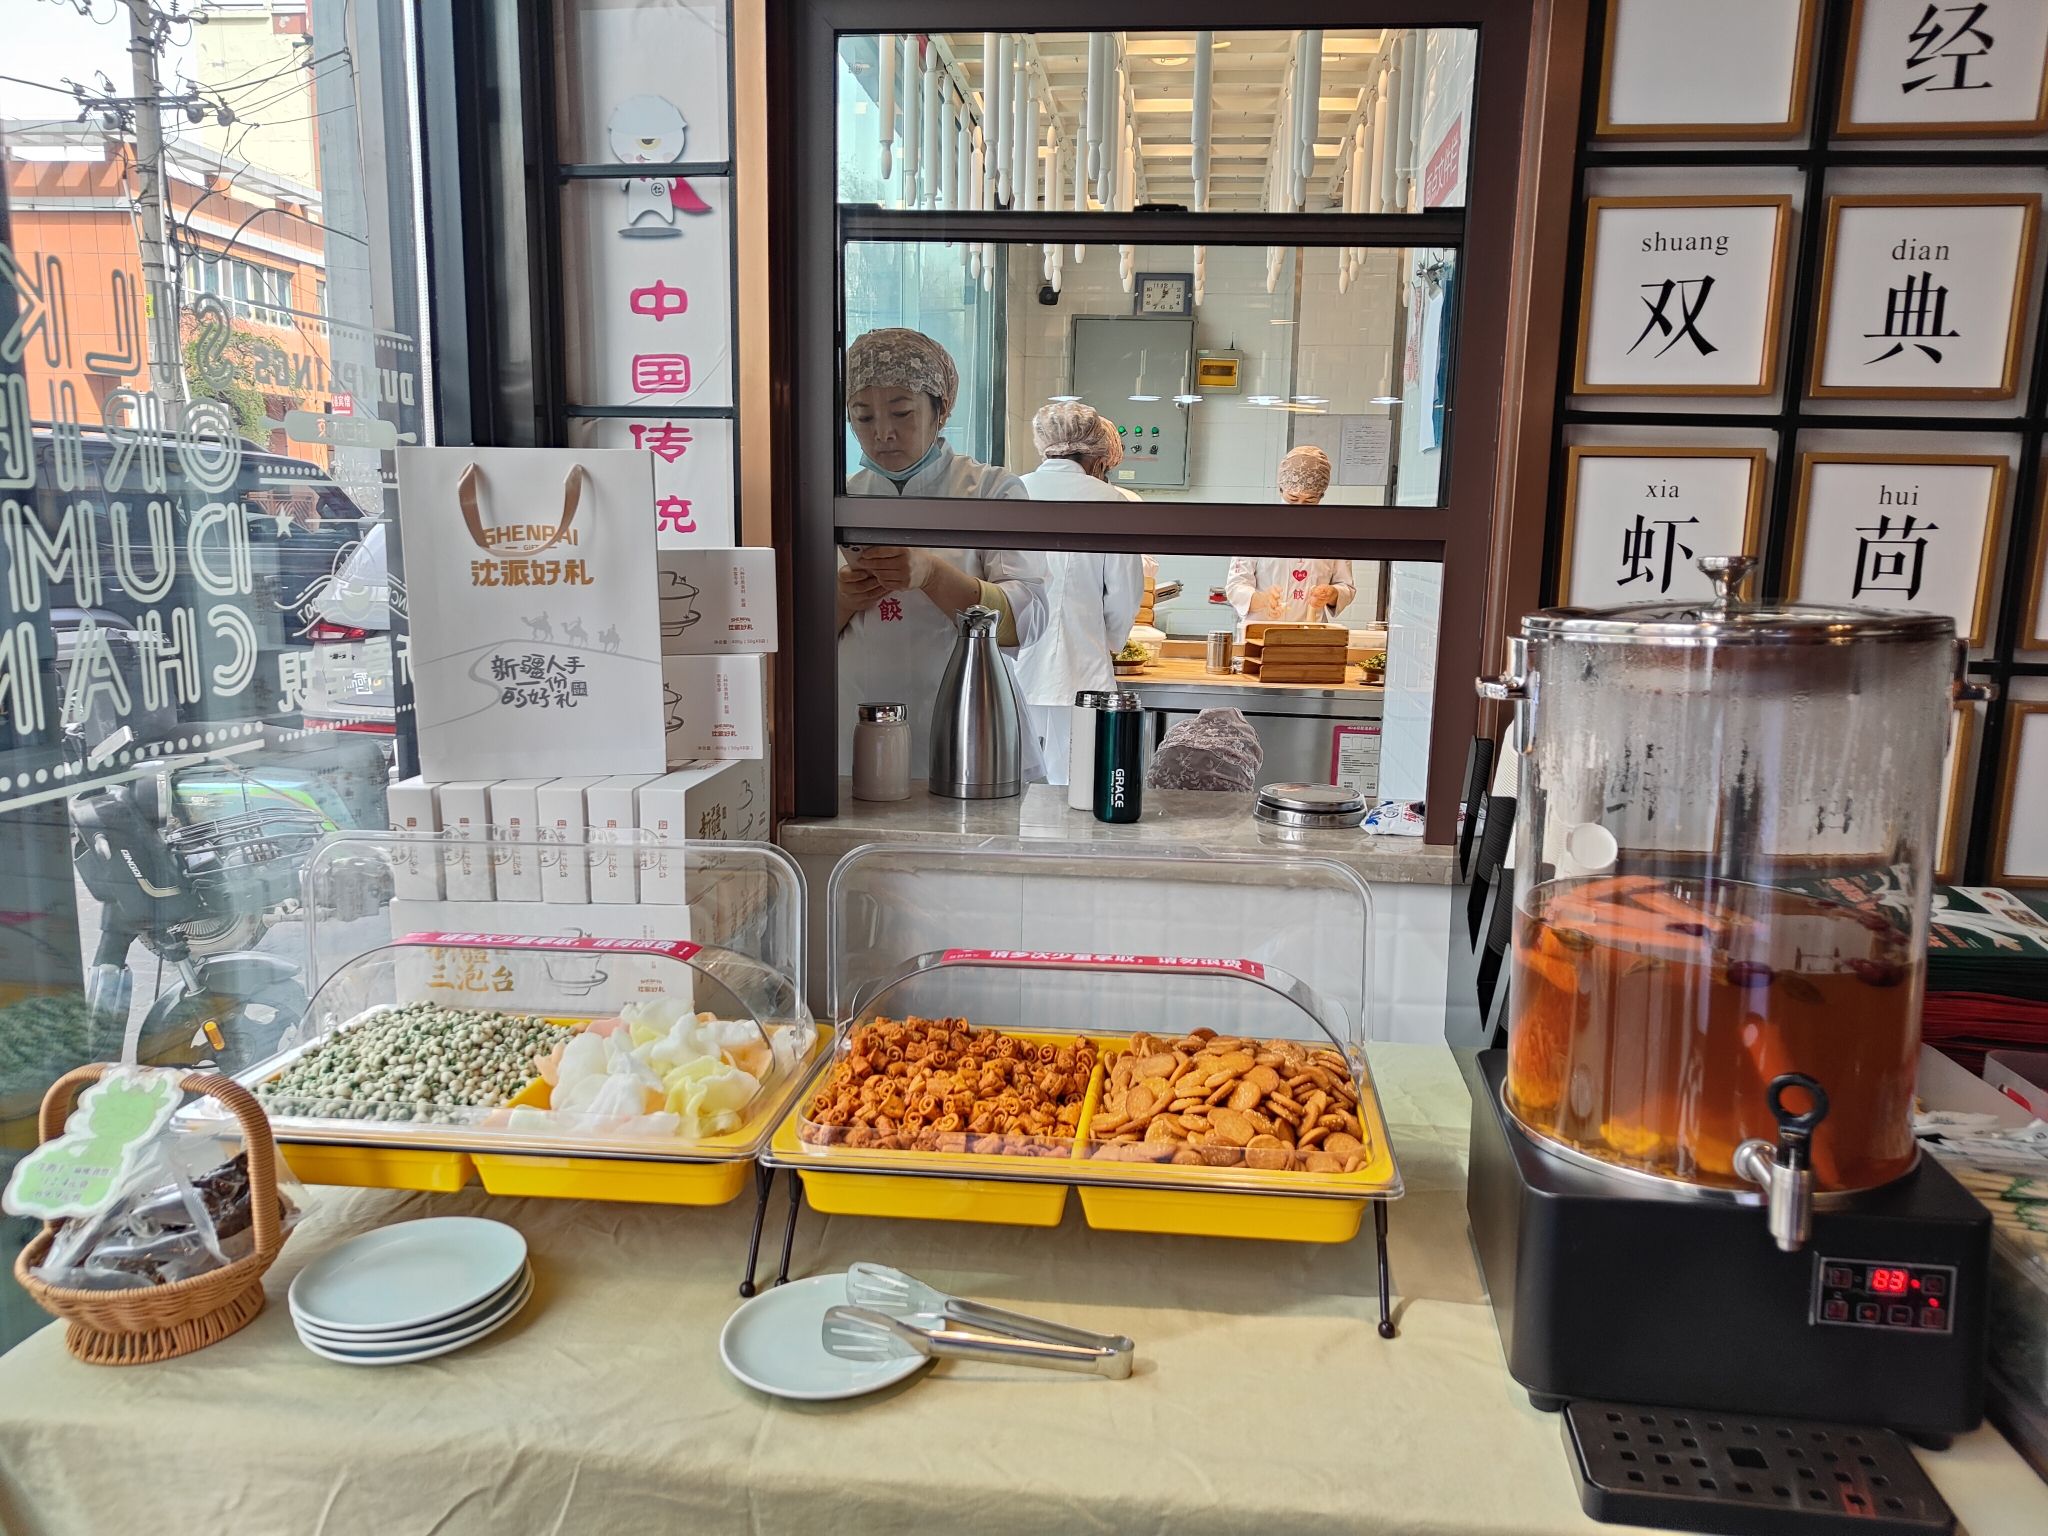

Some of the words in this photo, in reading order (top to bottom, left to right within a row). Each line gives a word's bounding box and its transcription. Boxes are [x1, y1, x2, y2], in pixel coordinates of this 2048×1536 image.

[1901, 2, 1994, 94] 经
[1641, 231, 1730, 255] shuang
[1891, 238, 1951, 262] dian
[1626, 274, 1719, 359] 双
[1863, 271, 1961, 365] 典
[1645, 479, 1681, 500] xia
[1878, 484, 1920, 506] hui
[1616, 514, 1700, 594] 虾
[1852, 515, 1939, 600] 茴
[471, 558, 595, 587] 沈派好礼
[491, 653, 586, 681] 新疆人手
[1115, 768, 1124, 808] GRACE
[426, 965, 514, 992] 三泡台
